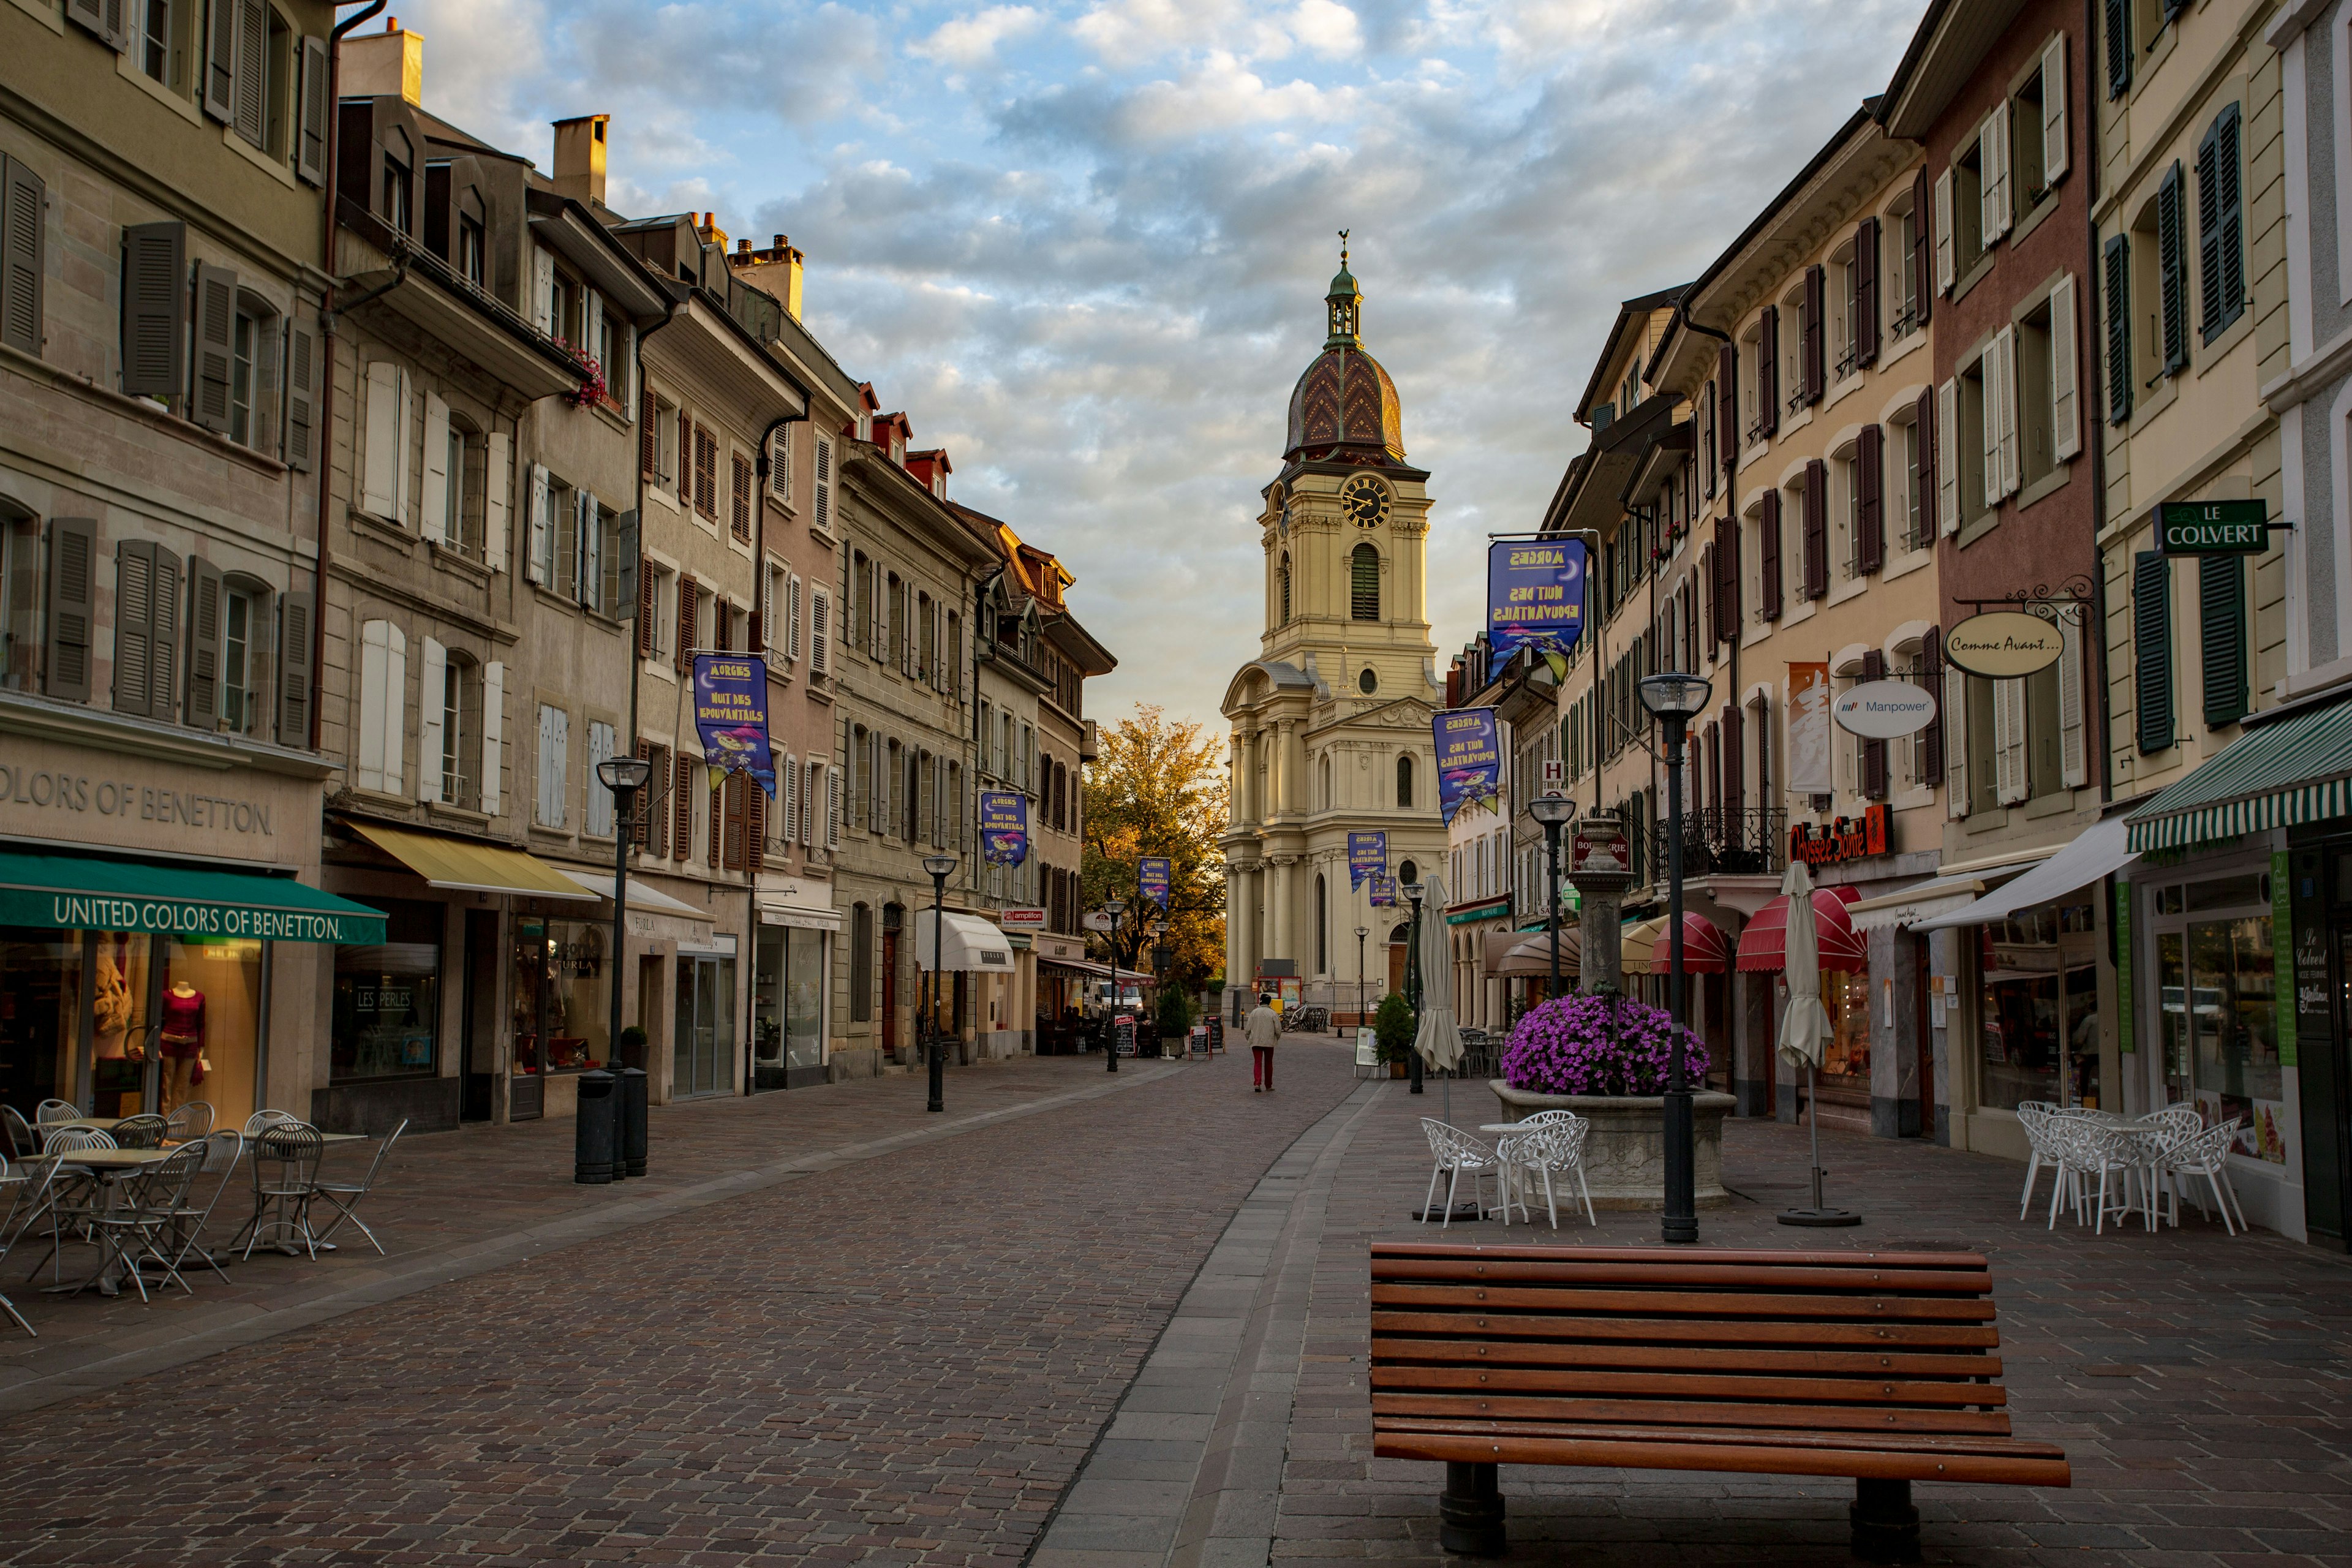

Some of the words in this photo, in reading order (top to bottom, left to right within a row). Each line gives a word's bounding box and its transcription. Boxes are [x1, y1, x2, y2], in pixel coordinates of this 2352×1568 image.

[2205, 507, 2220, 520] LE
[2167, 524, 2261, 545] COLVERT
[1951, 637, 2000, 651] Comme
[710, 664, 751, 677] MORGES
[711, 692, 731, 705] NUIT
[733, 693, 752, 706] DES
[699, 707, 764, 722] EPOUVANTAILS
[1866, 701, 1929, 714] Manpower
[96, 780, 135, 816] OF
[141, 786, 274, 836] BENETTON.
[984, 821, 1024, 831] EPOUVANTAILS
[1790, 822, 1833, 877] Odyssée
[1834, 816, 1866, 862] Santé
[54, 896, 138, 927] UNITED
[142, 902, 219, 933] COLORS
[224, 910, 250, 934] OF
[252, 911, 343, 940] BENETTON.
[1014, 911, 1042, 920] amplifon
[635, 918, 655, 931] FURLA
[2305, 927, 2317, 946] Le
[2296, 949, 2328, 966] Colvert
[358, 992, 374, 1008] LES
[379, 992, 411, 1008] PERLES
